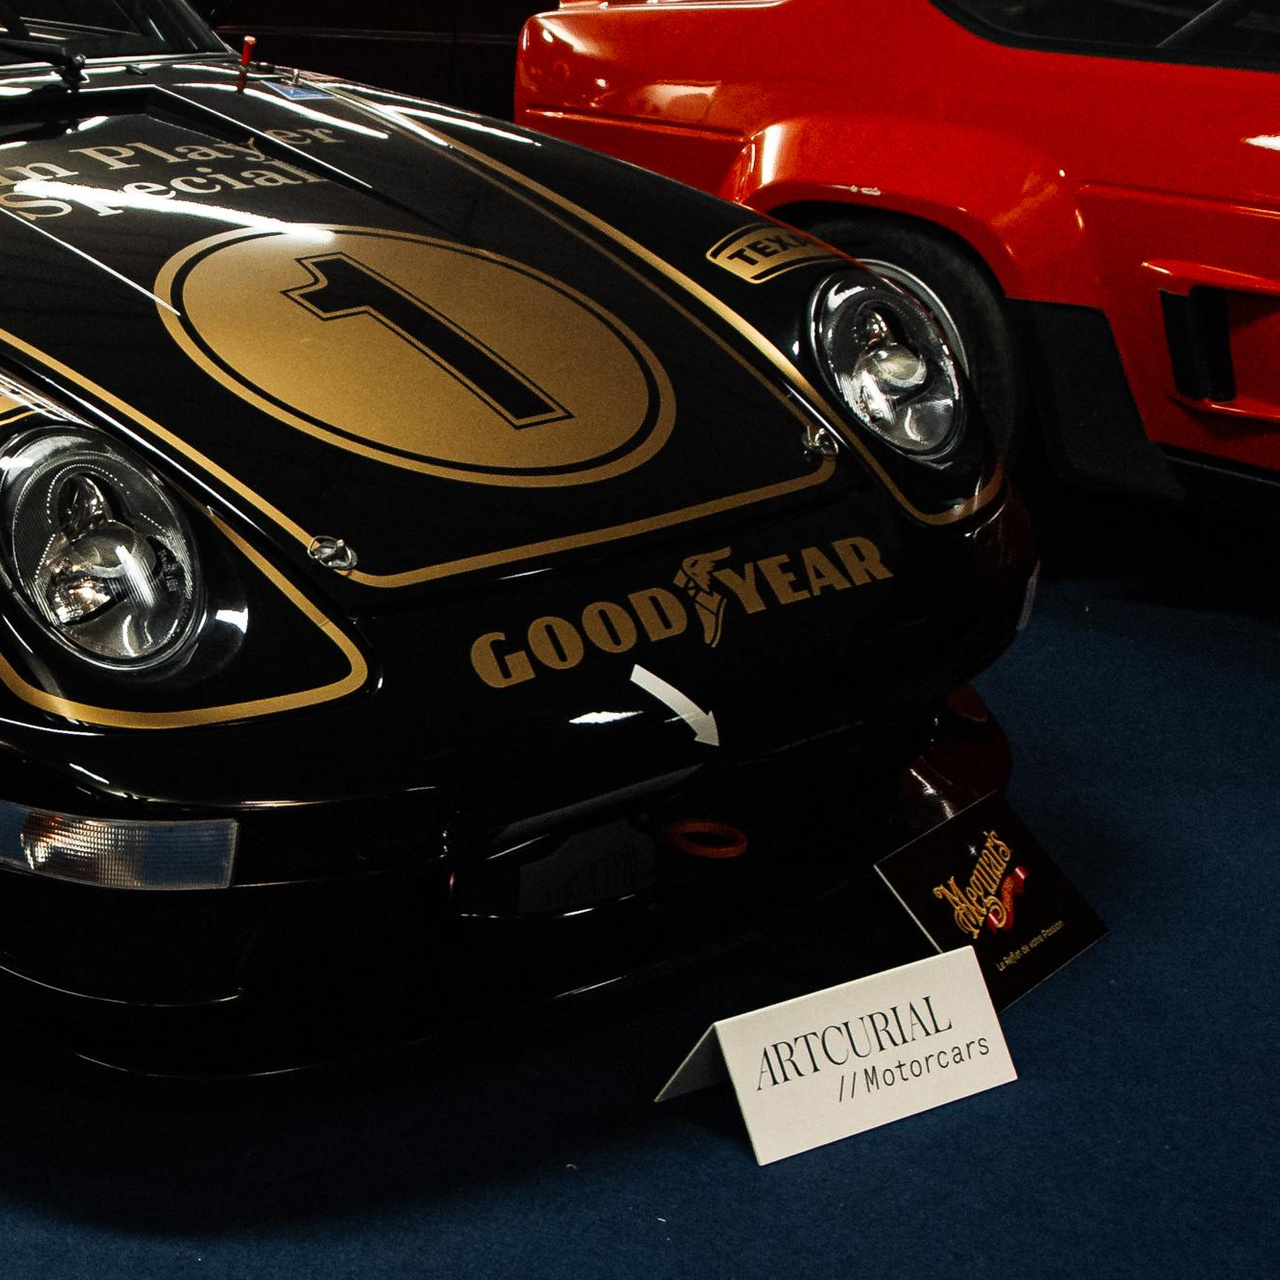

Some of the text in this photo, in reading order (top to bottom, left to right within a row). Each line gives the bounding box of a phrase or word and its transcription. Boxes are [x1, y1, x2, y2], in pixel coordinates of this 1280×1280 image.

[69, 128, 346, 170] Player
[280, 233, 575, 429] 1
[932, 830, 1013, 940] Meguiar's
[756, 995, 953, 1091] ARTCURIAL
[839, 1037, 990, 1102] //Motorcars
